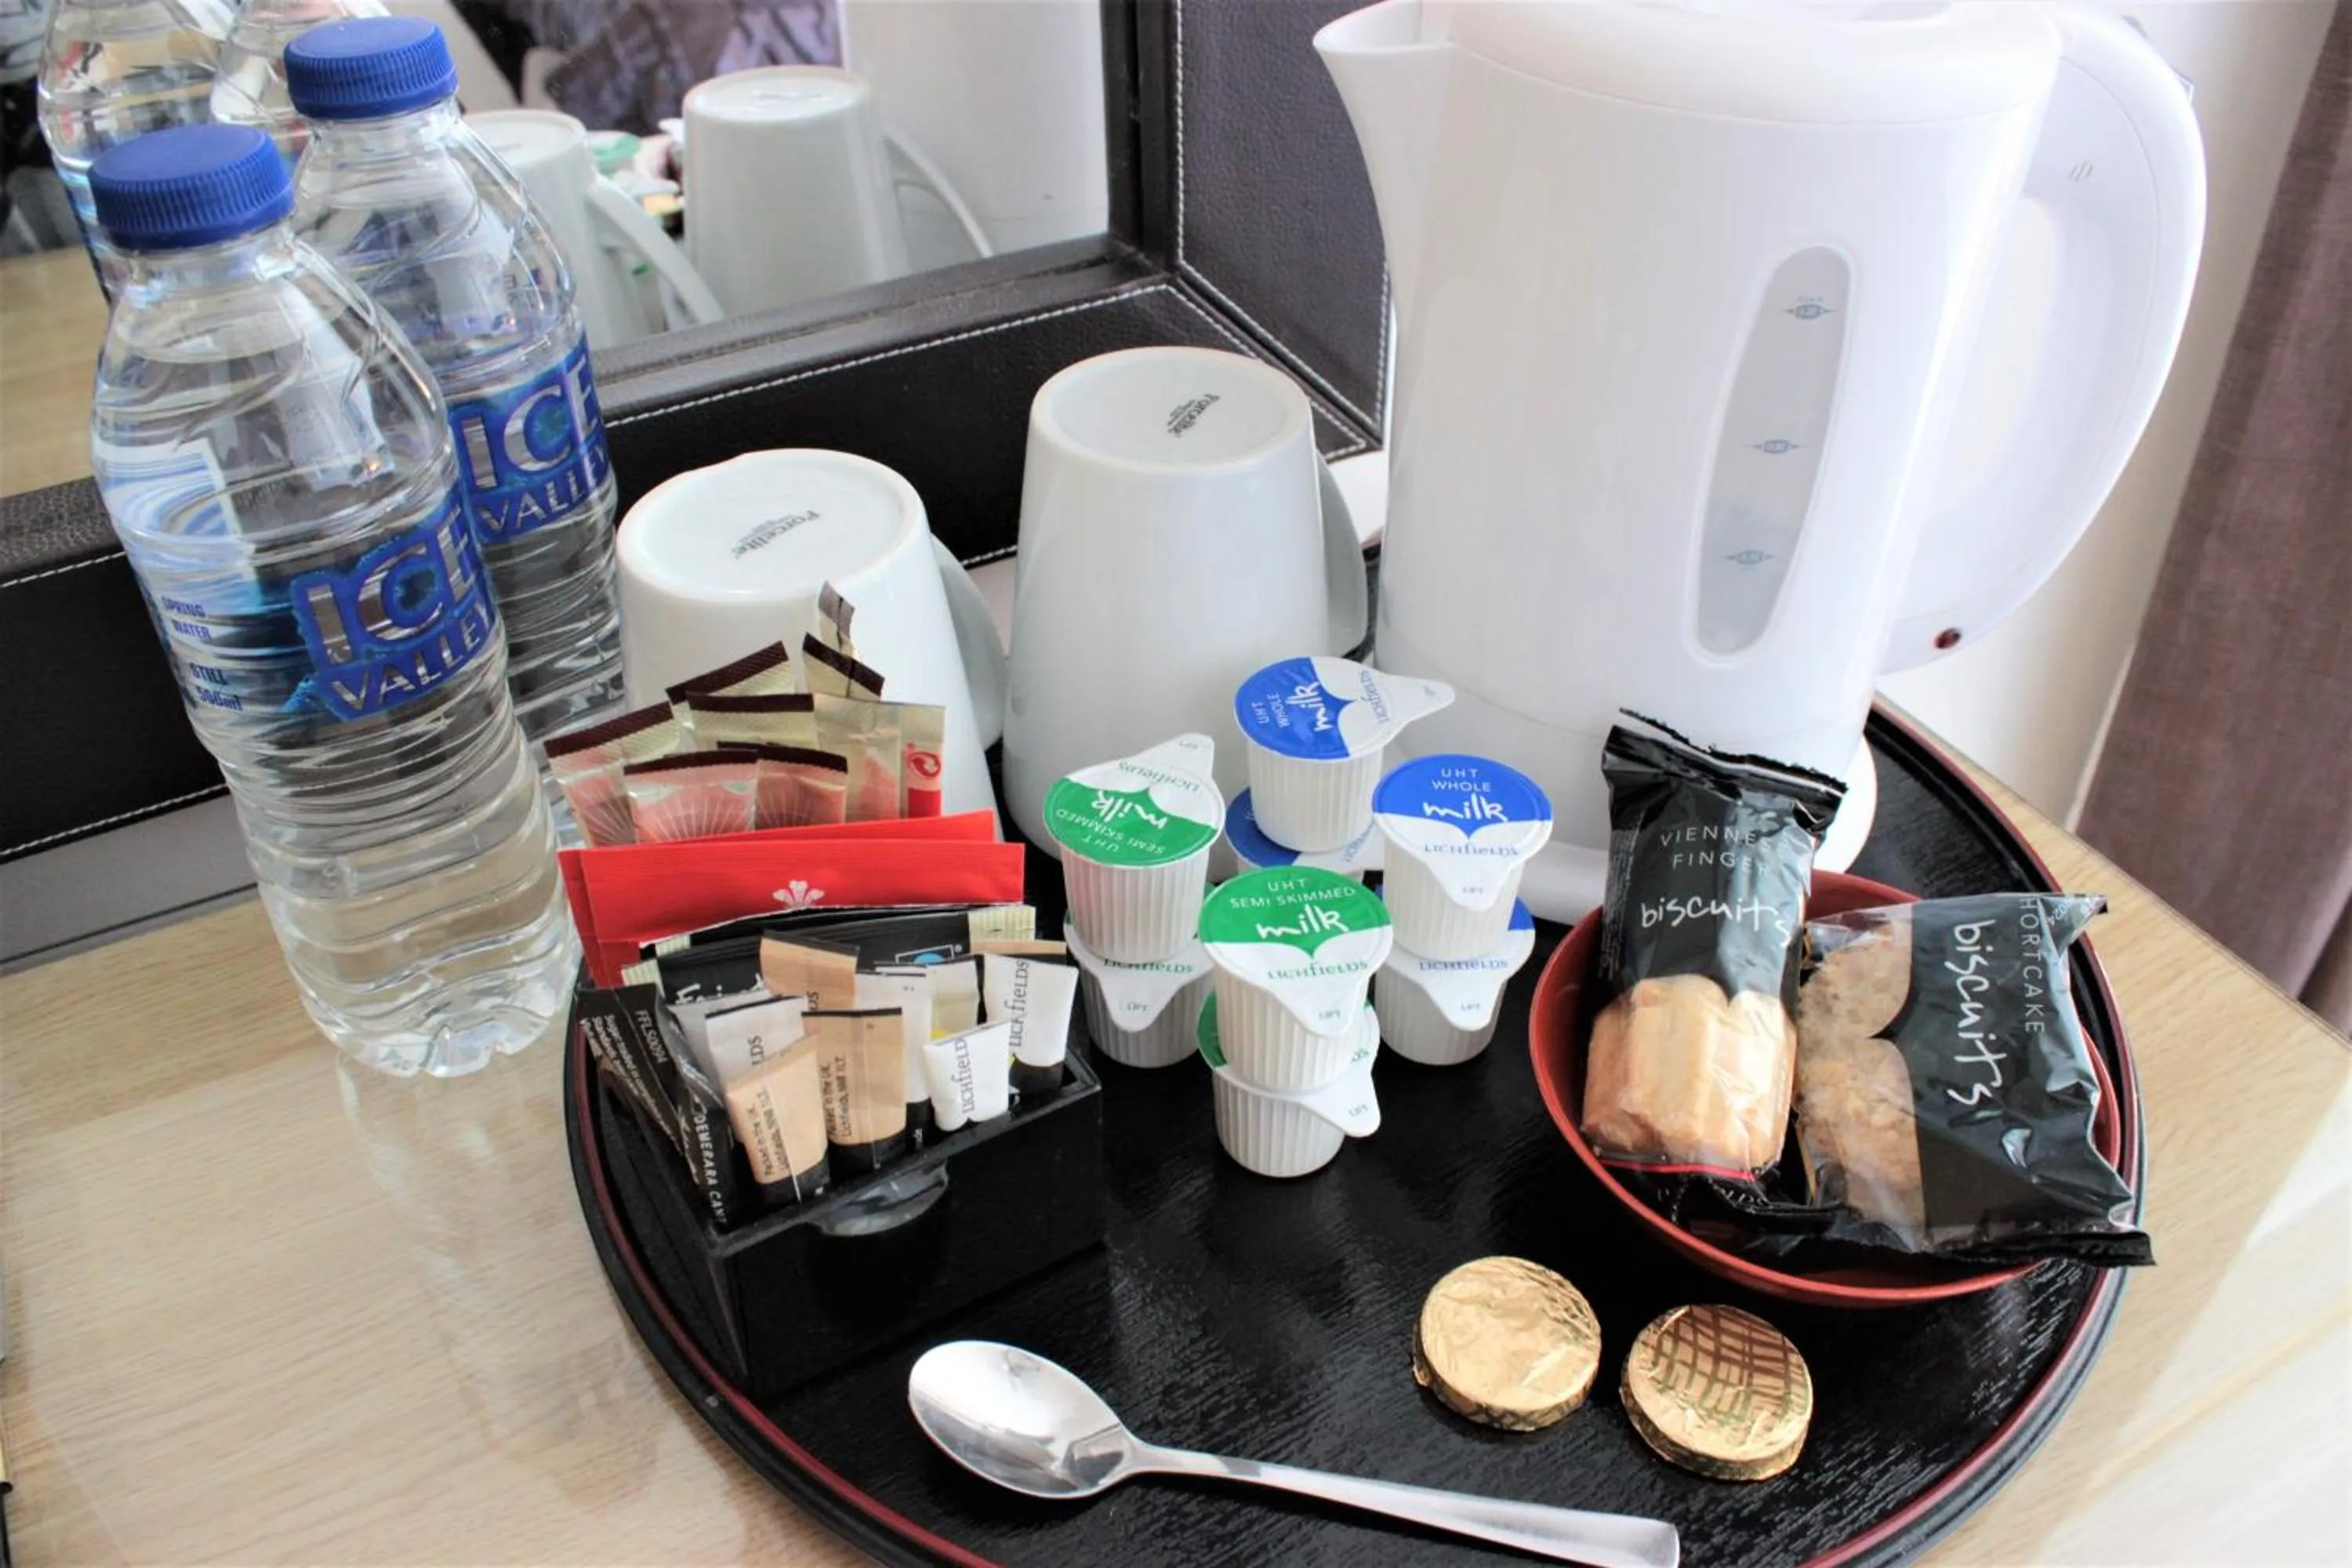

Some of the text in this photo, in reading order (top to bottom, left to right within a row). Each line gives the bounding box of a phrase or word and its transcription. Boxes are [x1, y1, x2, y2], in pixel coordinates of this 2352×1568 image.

[461, 355, 599, 487] ICE
[306, 503, 475, 664] ICE
[162, 596, 206, 618] SPRING
[171, 619, 212, 641] WATER
[190, 662, 229, 686] STILL
[1252, 700, 1269, 724] UHT
[1267, 692, 1288, 728] WHOLE
[1286, 681, 1333, 731] milk
[1432, 780, 1491, 792] WHOLE
[1441, 768, 1479, 778] UHT
[1091, 789, 1167, 829] milk
[1422, 793, 1508, 822] milk
[1056, 808, 1166, 855] SEMI SKIMMED
[1081, 834, 1120, 852] UHT
[1661, 825, 1771, 851] VIENNES
[1229, 886, 1356, 909] SEMI SKIMMED
[1268, 877, 1307, 891] UHT
[1256, 903, 1349, 939] milk
[1641, 896, 1791, 949] biscuits
[2020, 896, 2045, 1033] HORTCAKE
[1944, 919, 2007, 1105] biscuits
[694, 1116, 717, 1185] DEMERARA
